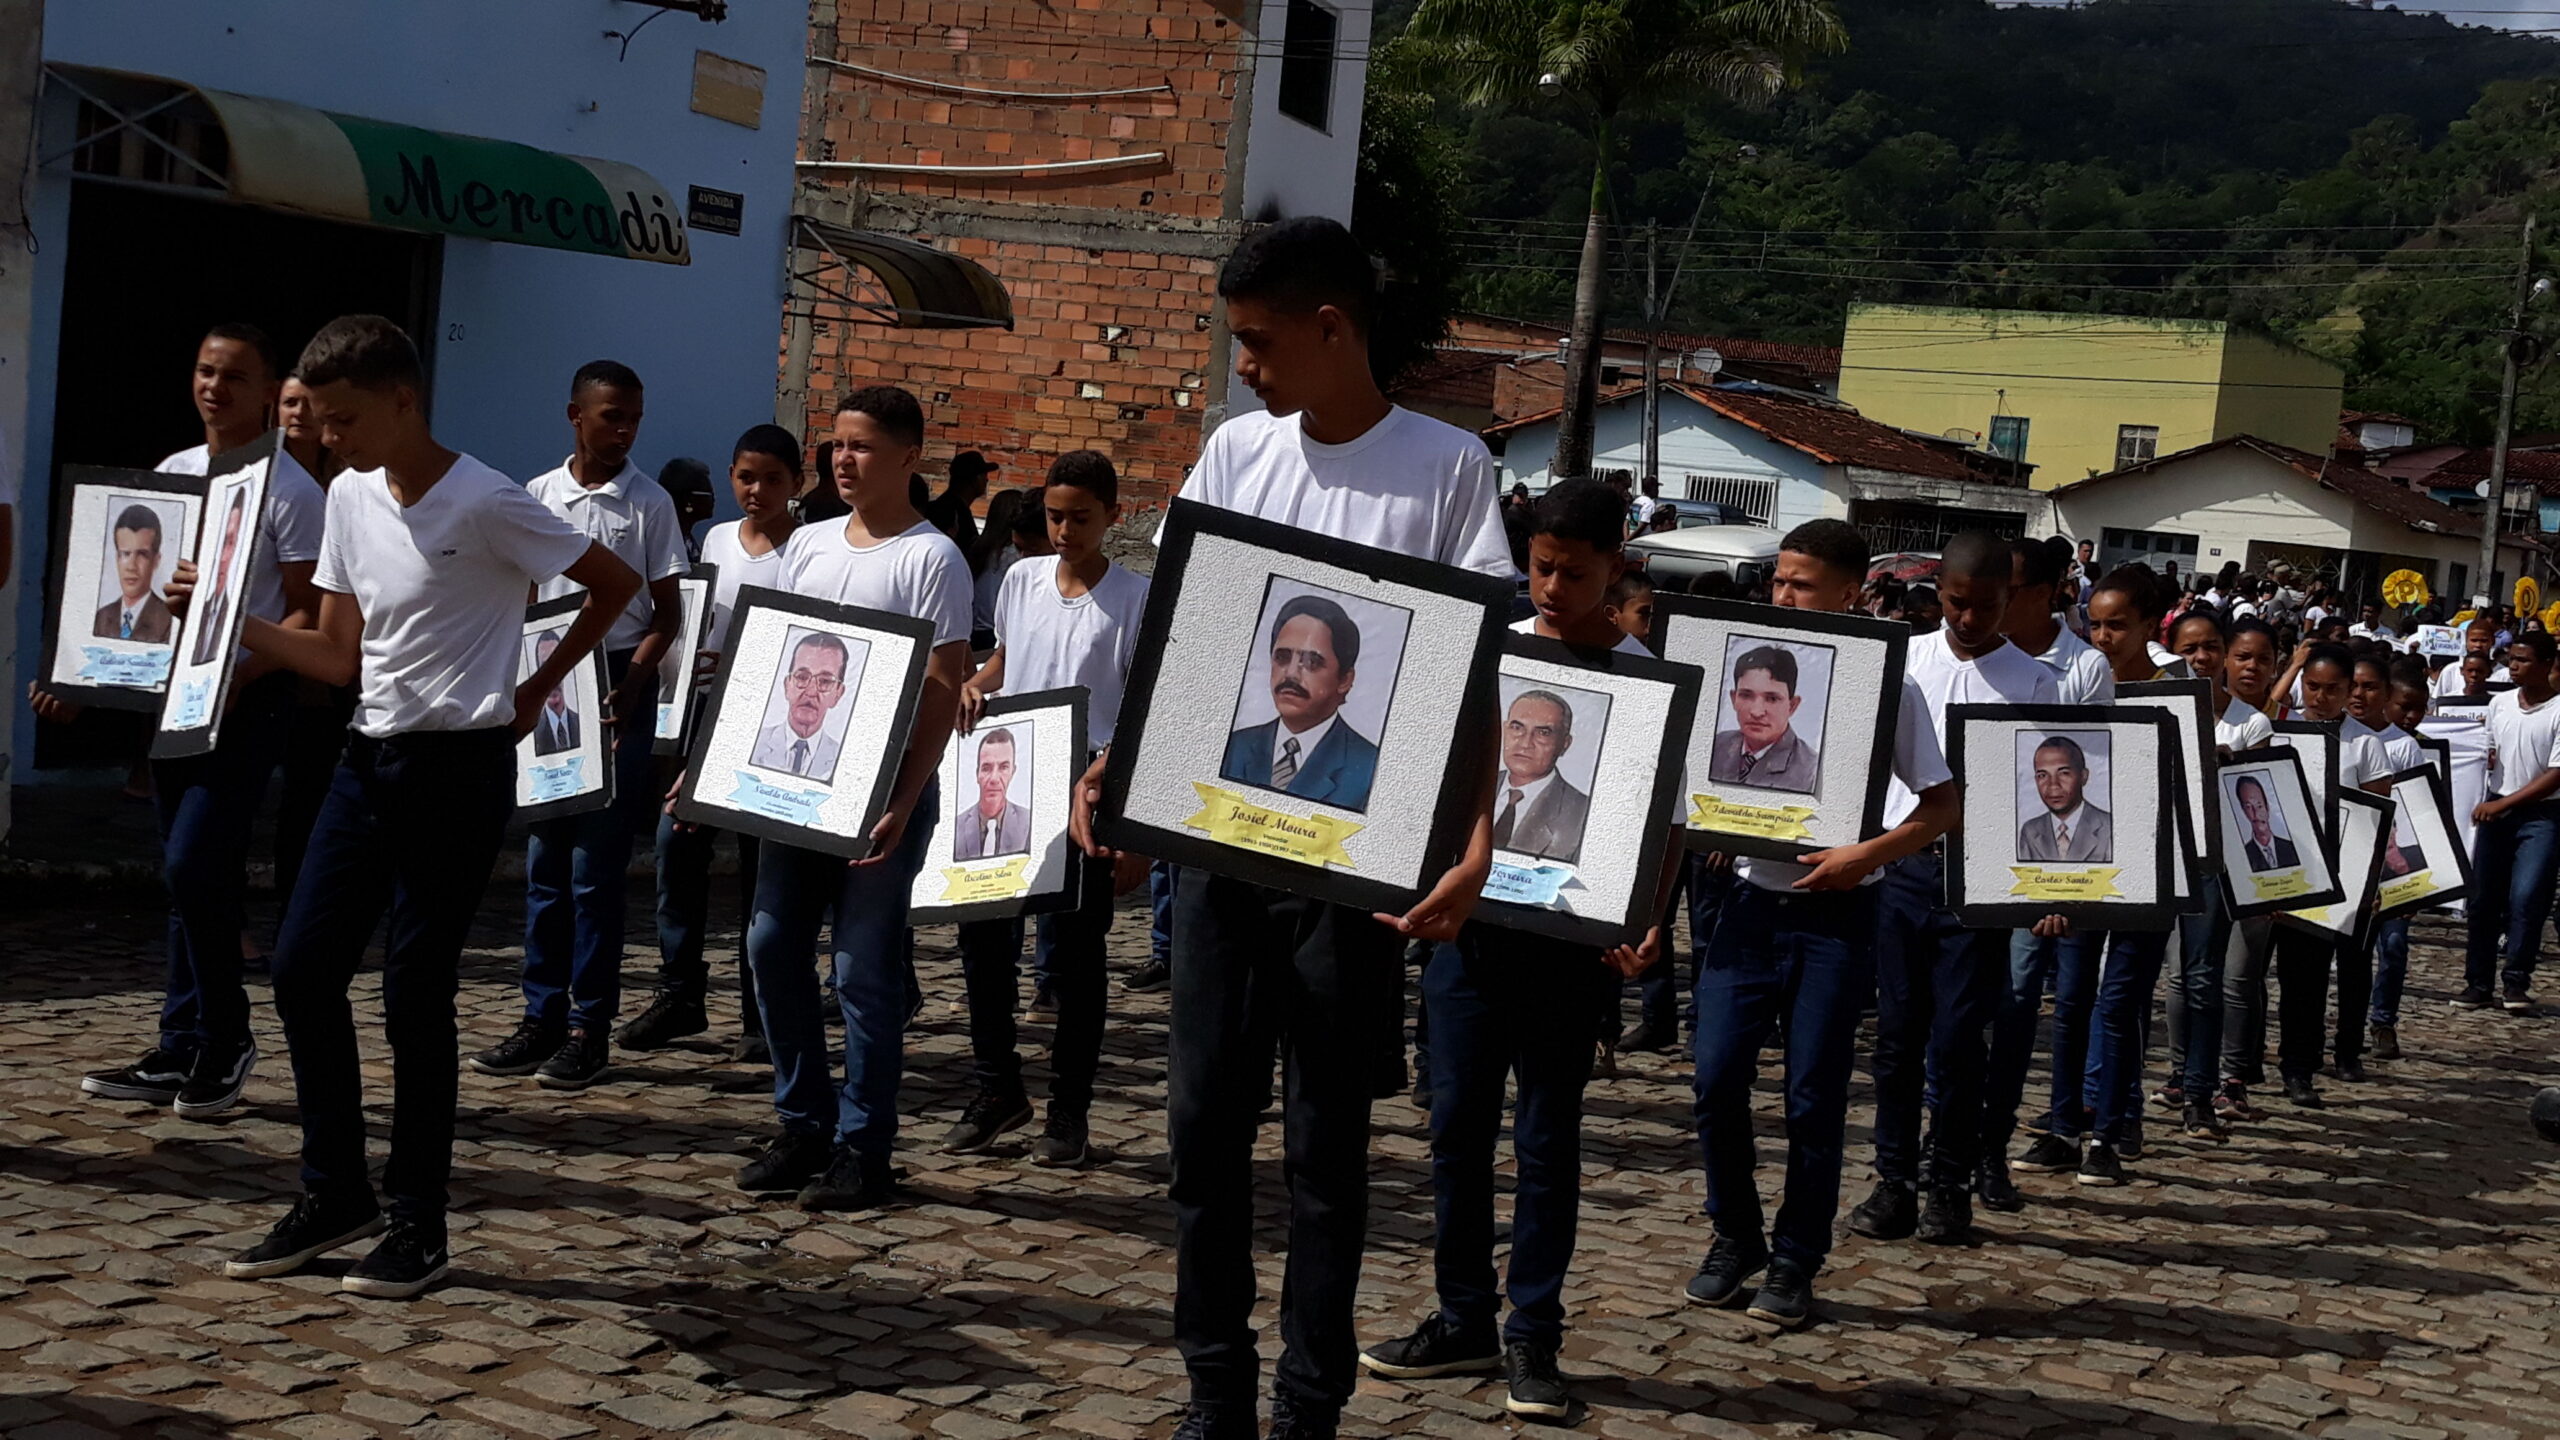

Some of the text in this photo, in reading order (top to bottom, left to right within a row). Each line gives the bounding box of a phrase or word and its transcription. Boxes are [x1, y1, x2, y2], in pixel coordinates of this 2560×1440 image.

[384, 152, 683, 257] Mercadi
[698, 191, 734, 209] AVENIDA
[449, 322, 464, 341] 20
[1228, 805, 1317, 839] Josiel Moura
[2034, 874, 2094, 885] Carlos Santos
